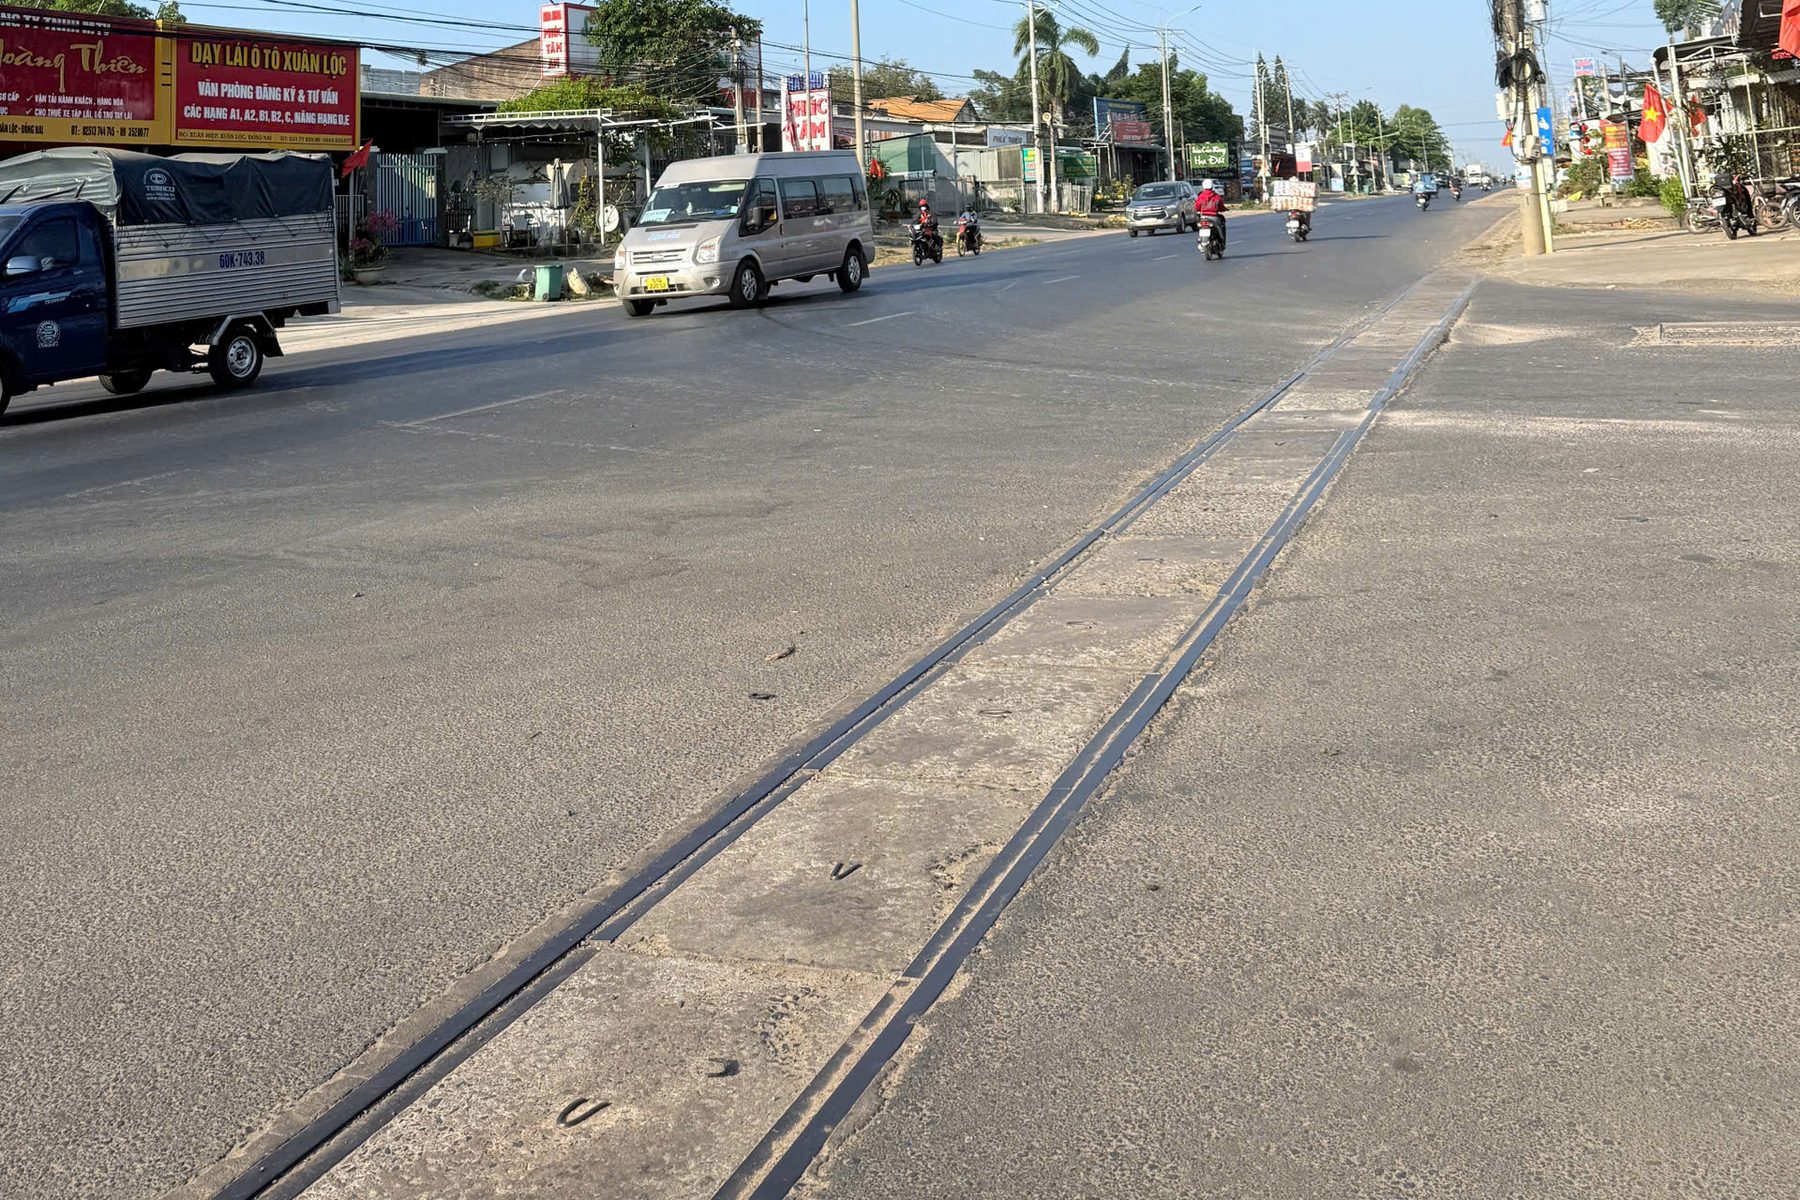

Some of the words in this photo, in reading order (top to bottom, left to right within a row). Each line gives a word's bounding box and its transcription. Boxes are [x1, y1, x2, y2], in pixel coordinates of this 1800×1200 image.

[191, 41, 222, 69] DẠY
[225, 41, 249, 67] LÁI
[250, 43, 261, 69] Ô
[263, 46, 280, 70] TÔ
[282, 49, 321, 74] XUÂN
[322, 51, 348, 79] LỘC
[220, 81, 254, 100] PHÒNG
[255, 83, 282, 102] ĐĂNG
[297, 90, 306, 103] &
[306, 89, 321, 104] TƯ
[321, 87, 339, 105] VẤN
[183, 103, 202, 119] CÁC
[203, 106, 228, 121] HẠNG
[229, 108, 243, 122] A1,
[243, 109, 258, 123] A2,
[219, 251, 266, 269] 60K-743.38
